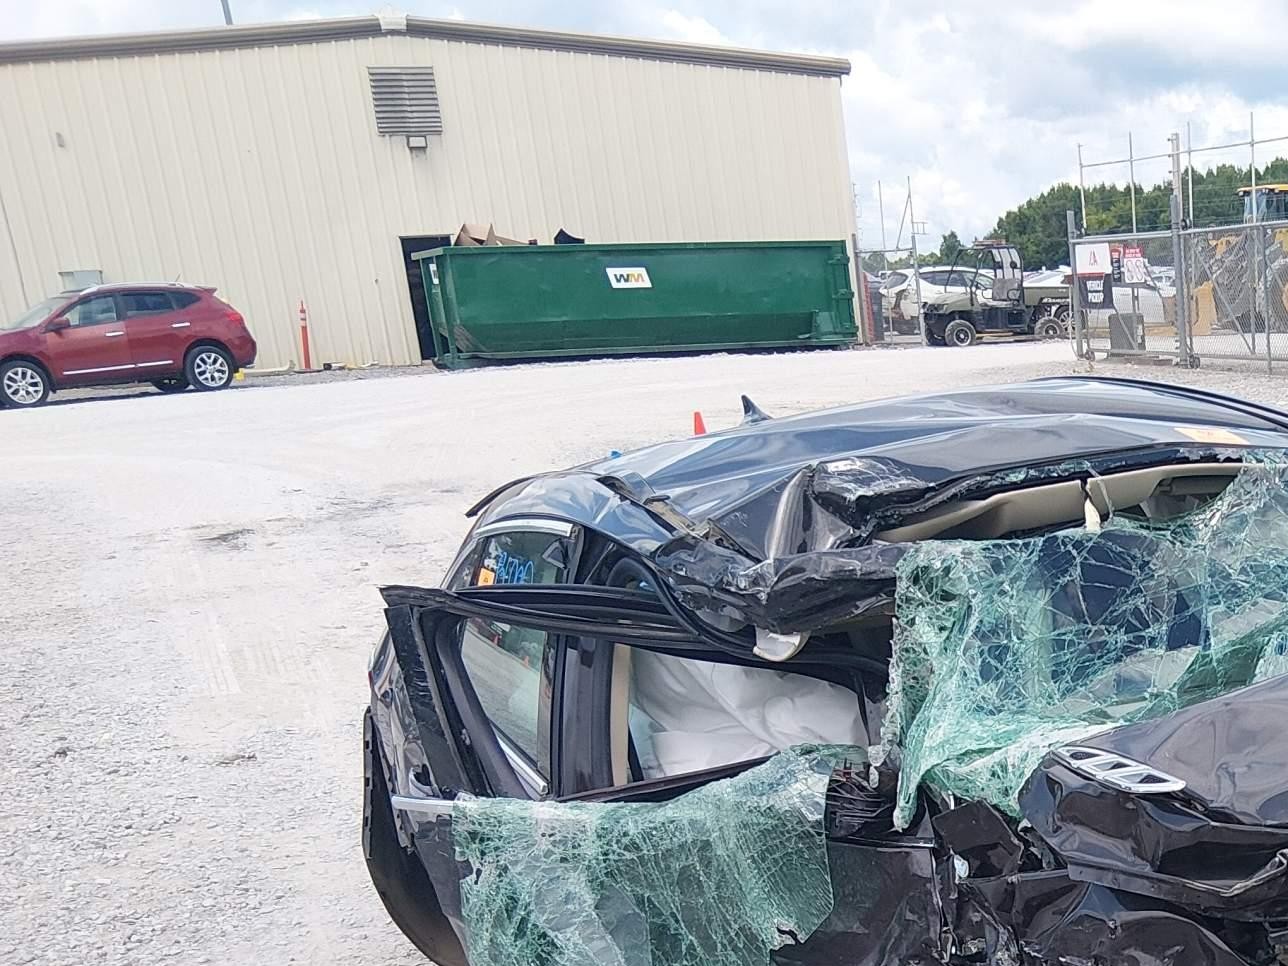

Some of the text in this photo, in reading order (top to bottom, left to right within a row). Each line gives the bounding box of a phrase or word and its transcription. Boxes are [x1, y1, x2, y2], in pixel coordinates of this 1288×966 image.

[613, 273, 645, 283] WM
[1086, 280, 1104, 291] VEHICLE
[1087, 292, 1104, 303] PICKUP
